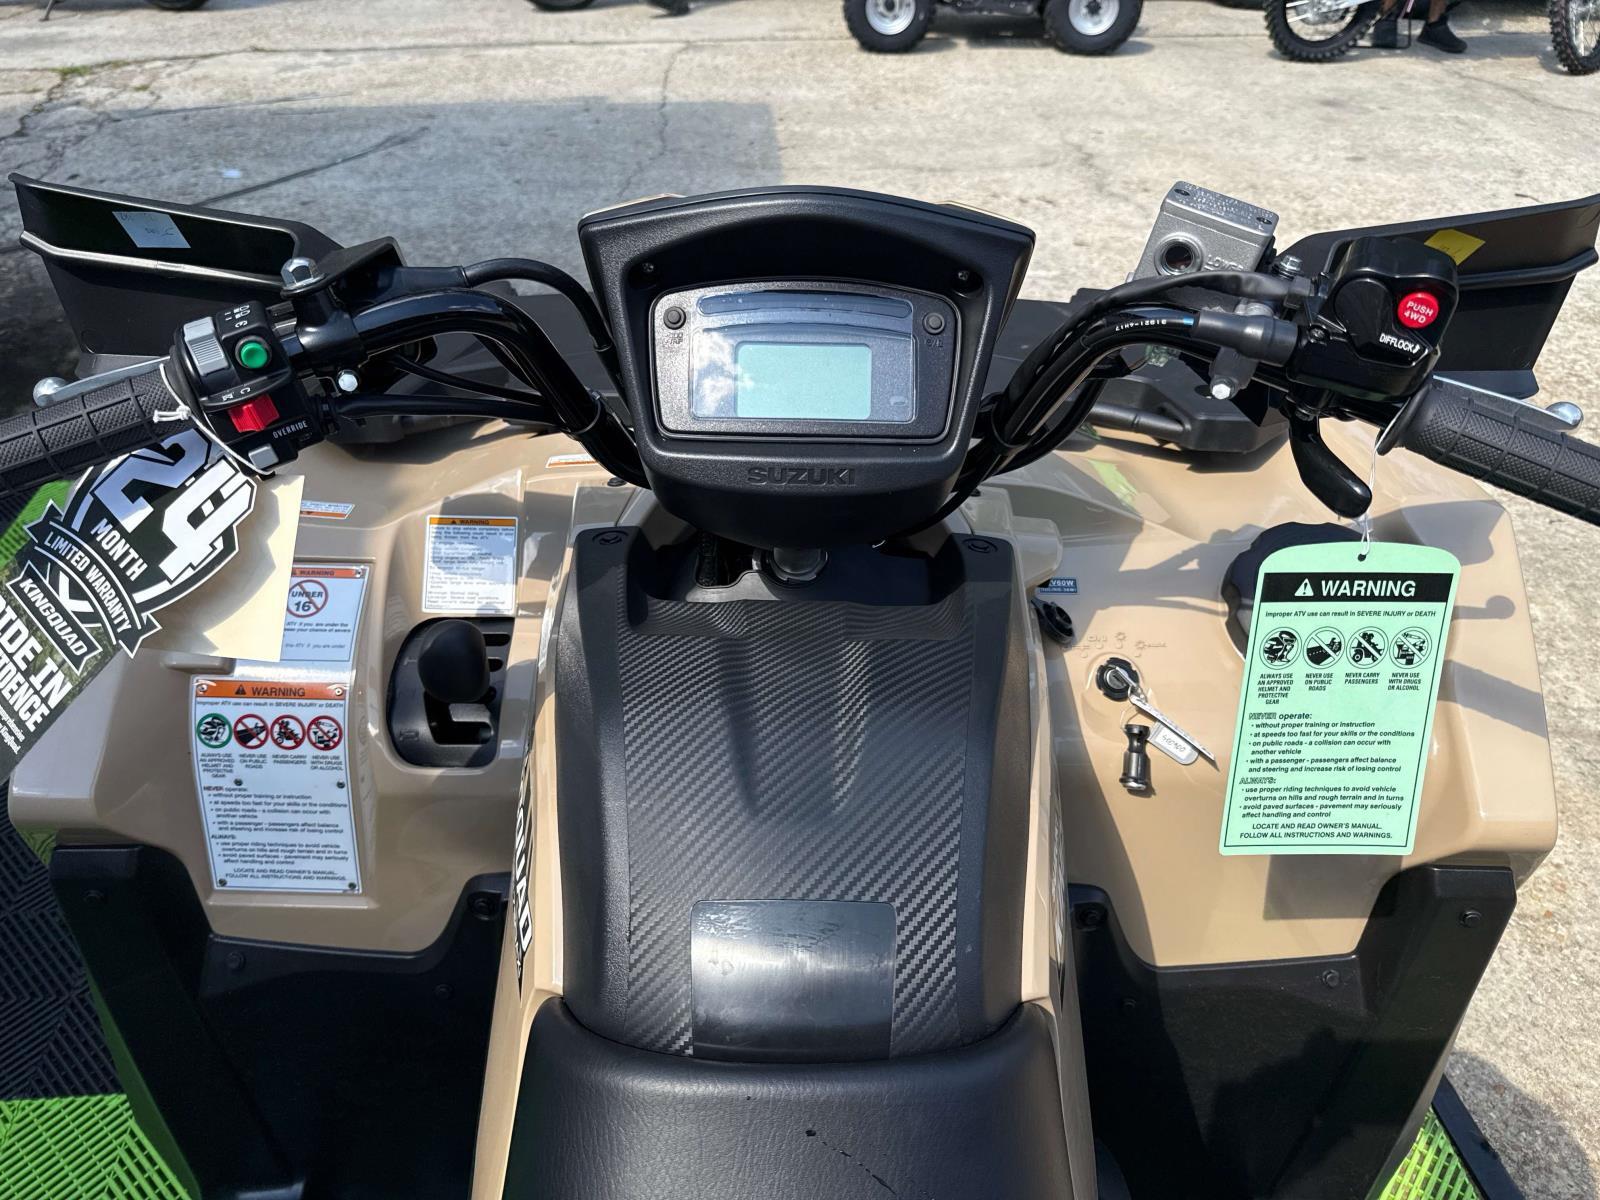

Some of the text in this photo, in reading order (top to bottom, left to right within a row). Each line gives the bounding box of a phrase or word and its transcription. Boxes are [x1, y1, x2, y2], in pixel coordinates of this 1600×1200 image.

[1404, 310, 1426, 324] 4WD
[1406, 301, 1434, 317] PUSH
[1379, 333, 1415, 353] DIFFLOCK
[272, 420, 308, 438] OVERRIDE
[748, 467, 856, 487] SUZUKI
[90, 518, 148, 581] MONTH
[43, 531, 132, 633] LIMITED WARRANTY
[1050, 580, 1074, 588] V60W
[1321, 580, 1416, 597] WARNING
[291, 590, 323, 598] UNDER
[294, 601, 312, 612] 16
[19, 578, 88, 656] KINGQUAD
[29, 656, 73, 710] IN
[252, 687, 305, 697] WARNING
[1278, 712, 1312, 721] operate:
[1304, 785, 1341, 793] techniques
